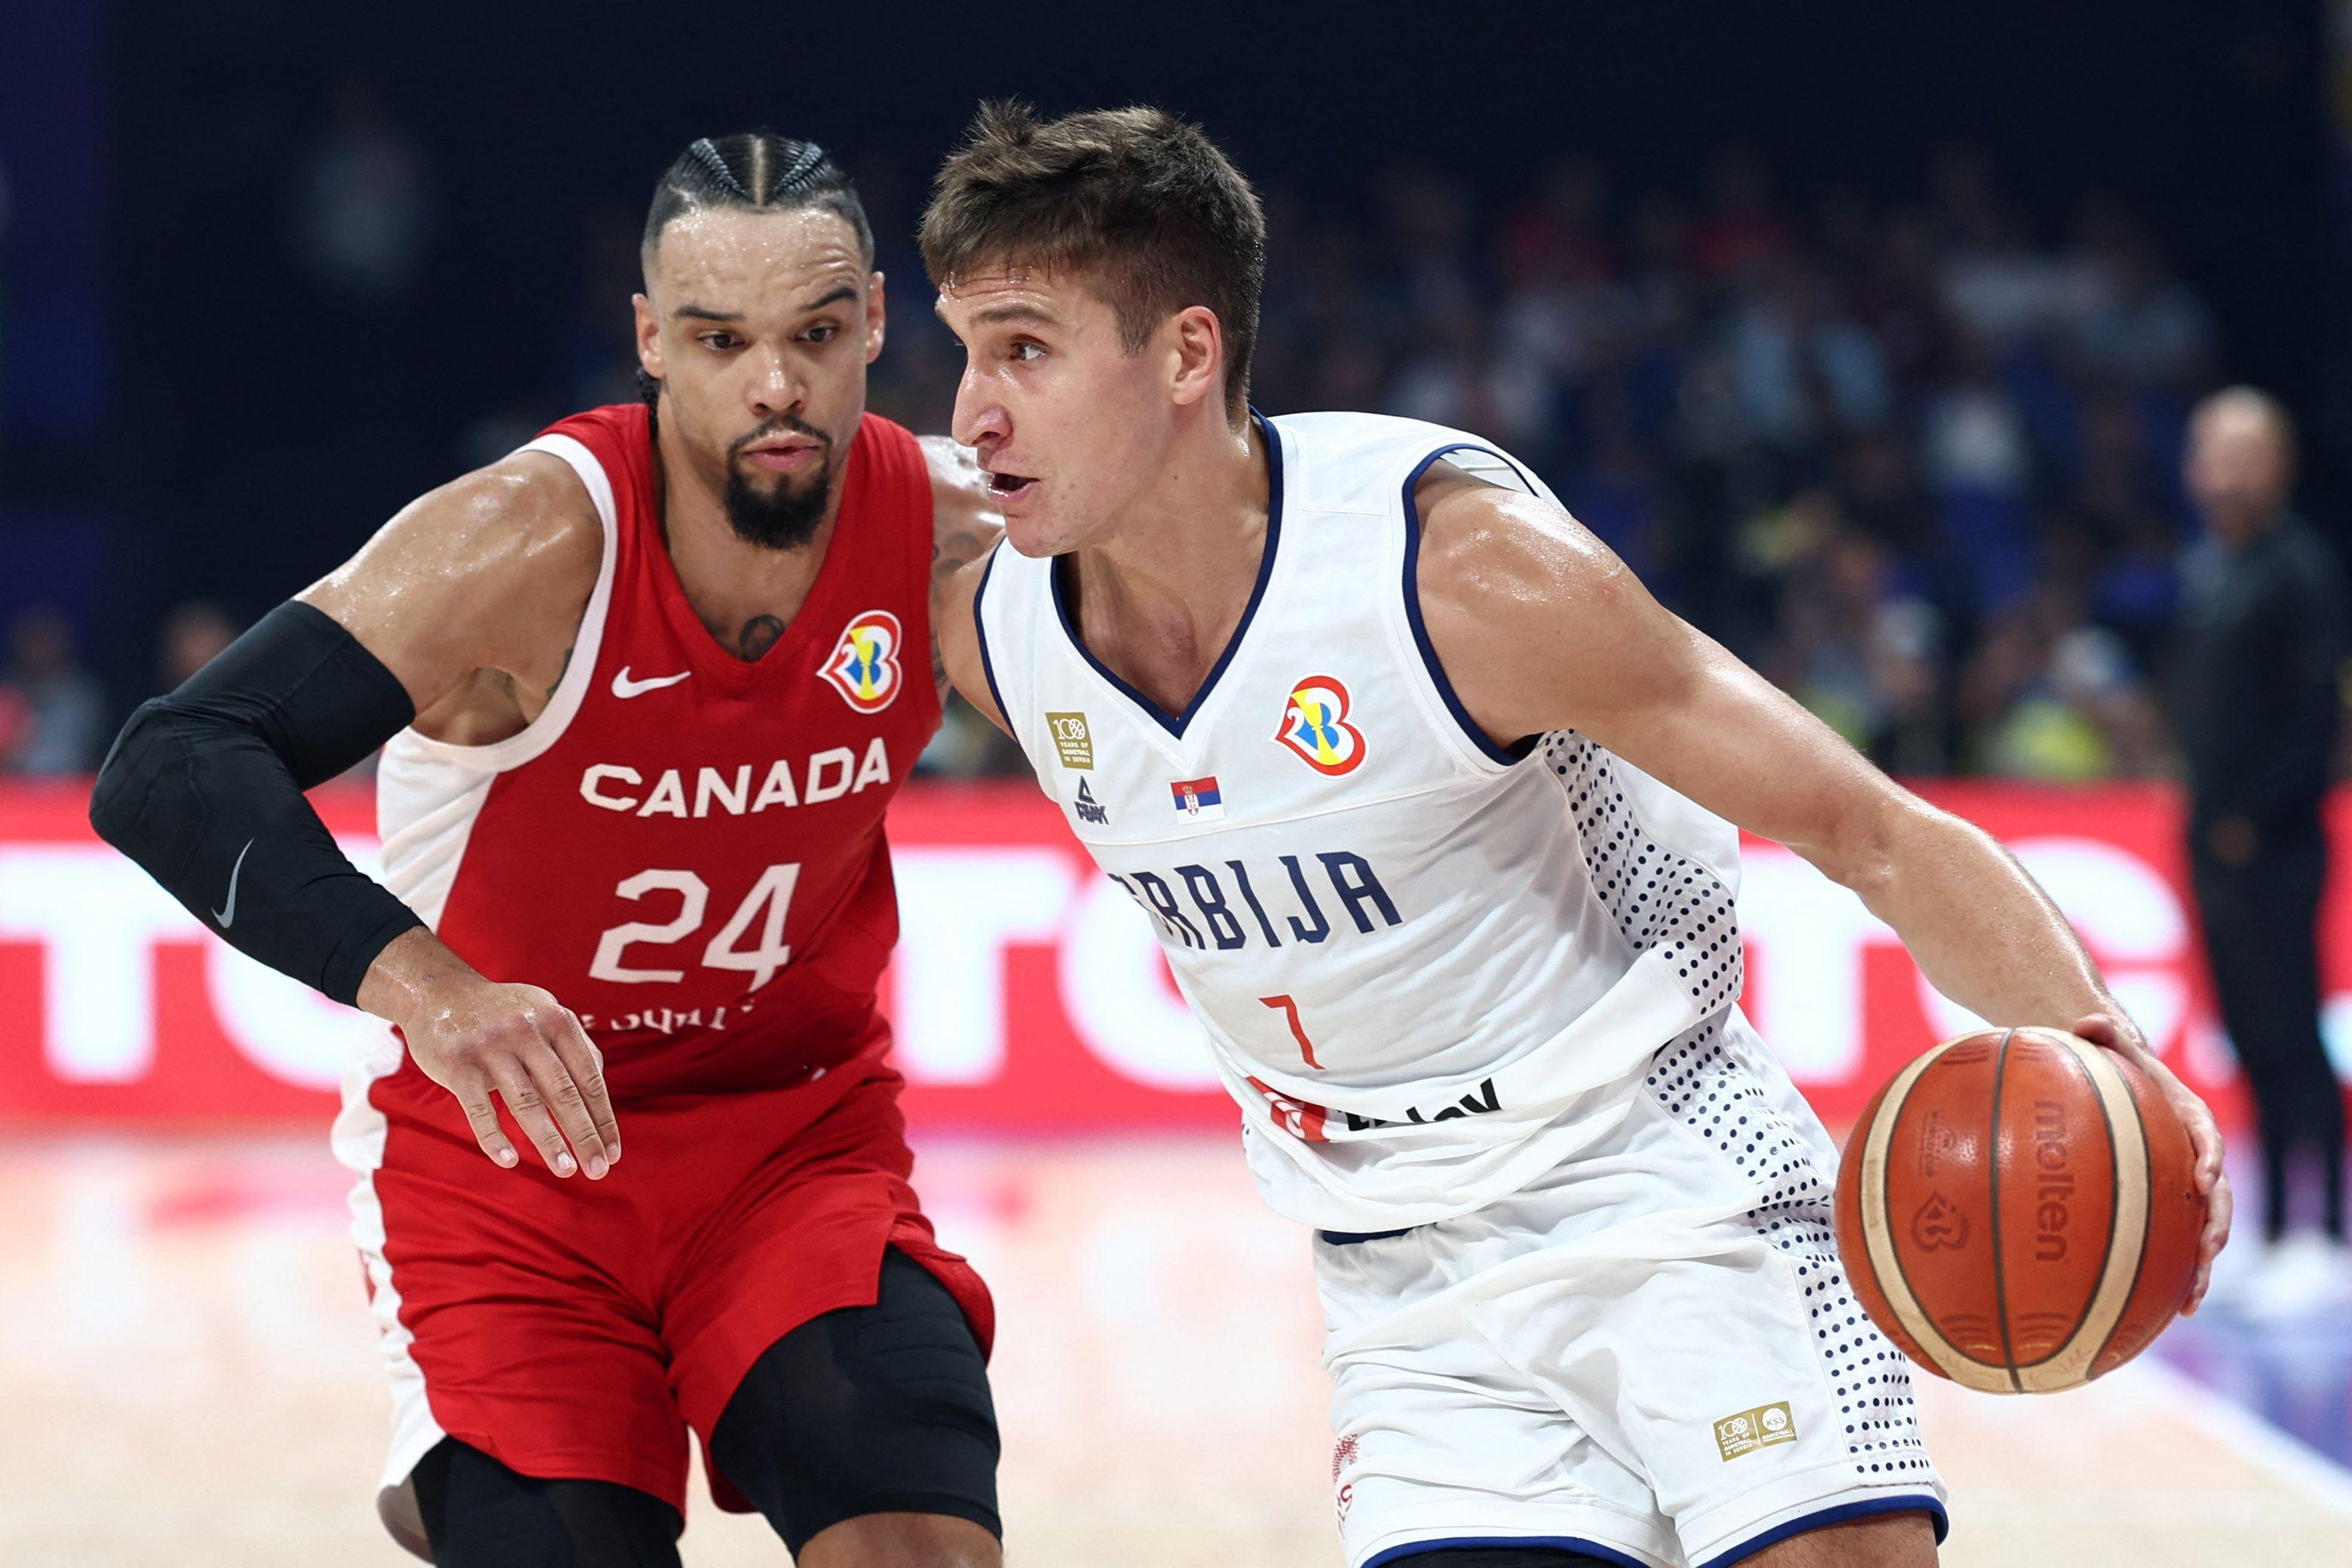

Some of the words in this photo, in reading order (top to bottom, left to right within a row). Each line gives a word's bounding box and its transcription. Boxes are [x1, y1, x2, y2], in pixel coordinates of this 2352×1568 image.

[580, 737, 890, 818] CANADA
[1074, 801, 1110, 825] PEAK
[588, 863, 801, 992] 24
[1258, 994, 1326, 1070] 7
[2035, 1101, 2075, 1262] molten
[1766, 1417, 1784, 1426] KSS
